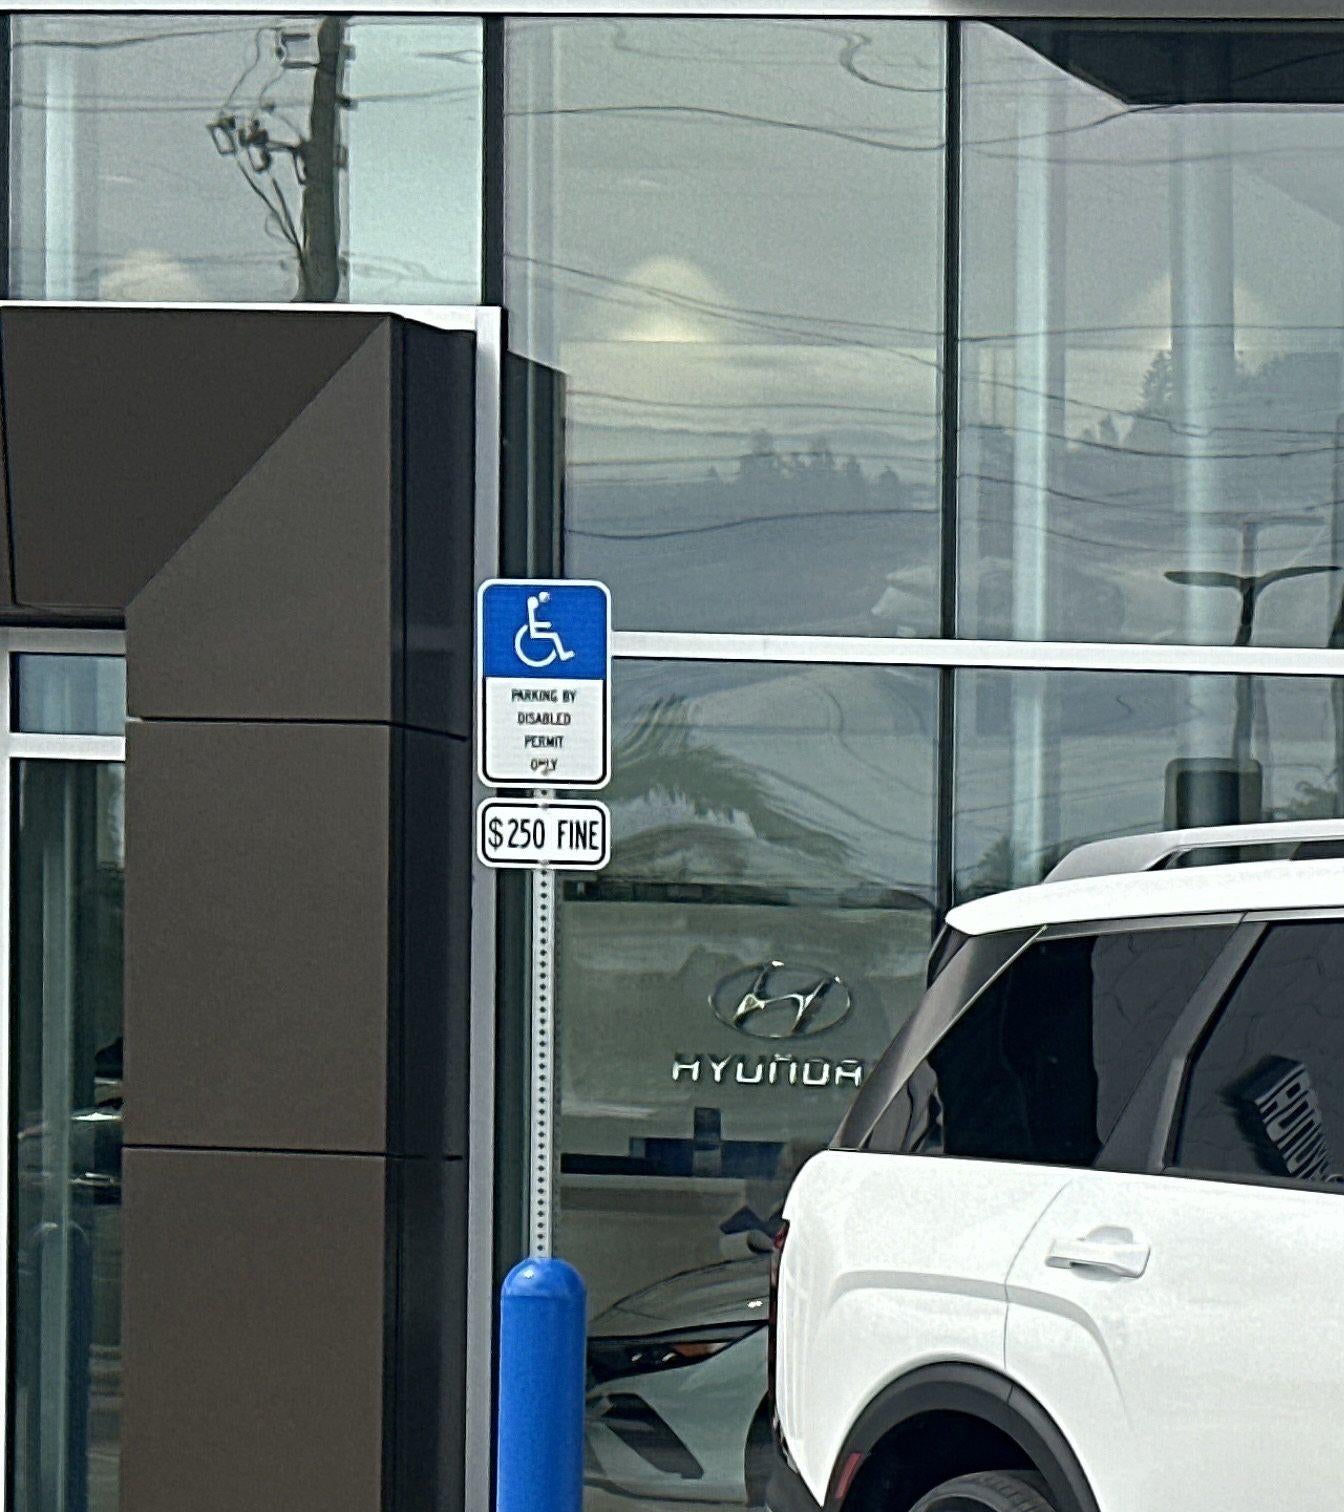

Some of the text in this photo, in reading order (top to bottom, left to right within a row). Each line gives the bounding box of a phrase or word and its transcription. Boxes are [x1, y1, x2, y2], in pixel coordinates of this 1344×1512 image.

[511, 688, 577, 704] PARKING BY
[517, 711, 571, 726] DISABLED
[524, 735, 564, 749] PERMIT
[488, 816, 600, 851] $250 FINE
[672, 1052, 864, 1087] HYUNDA
